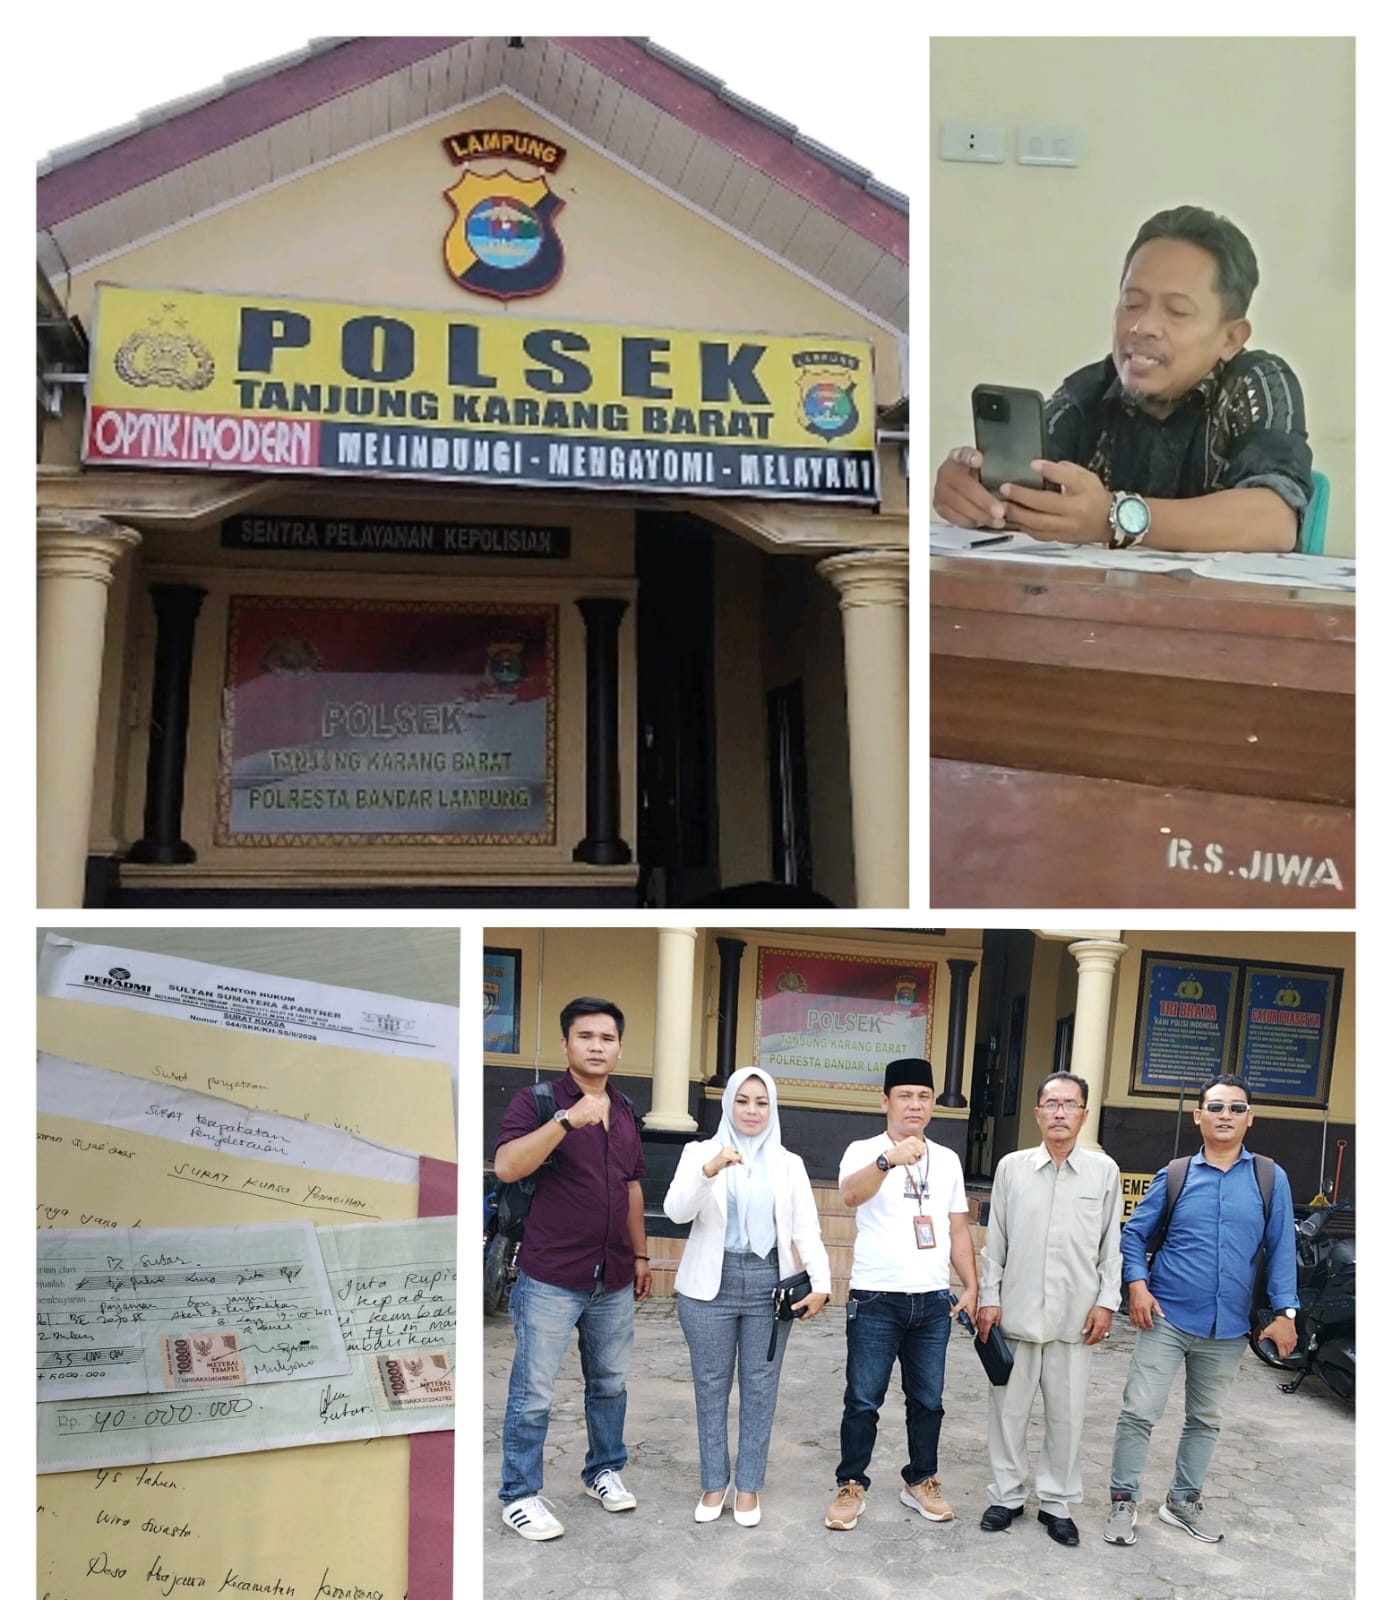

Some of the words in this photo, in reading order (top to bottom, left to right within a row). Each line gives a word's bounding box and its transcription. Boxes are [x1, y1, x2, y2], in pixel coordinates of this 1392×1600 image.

[451, 133, 558, 163] LAMPUNG
[237, 307, 771, 406] POLSEK
[234, 379, 440, 421] TANJUNG
[452, 390, 629, 432] KARANG
[642, 406, 775, 440] BARAT
[338, 431, 522, 474] MELINDUNGI
[549, 443, 715, 483] MENGAYOMI
[741, 452, 872, 490] MELAYANI
[241, 519, 319, 546] SENTRA
[325, 522, 434, 550] PELAYANAN
[444, 527, 551, 552] KEPOLISIAN
[321, 701, 467, 738] POLSEK
[271, 750, 362, 773] TANJUNG
[368, 752, 447, 772] KARANG
[452, 752, 513, 771] BARAT
[249, 787, 348, 810] POLRESTA
[356, 788, 433, 810] BANDAR
[438, 788, 530, 810] LAMPUNG
[84, 974, 152, 993] PERADMI
[217, 984, 257, 996] KANTOR
[259, 991, 296, 1002] HUKUM
[168, 984, 214, 998] SULTAN
[216, 993, 278, 1009] SUMATERA
[190, 1014, 218, 1025] Nomor
[223, 1012, 253, 1024] SURAT
[254, 1017, 286, 1029] KUASA
[807, 1009, 882, 1034] POLSEK
[1160, 1000, 1178, 1018] TRI
[1179, 1002, 1218, 1021] BRATA
[779, 1034, 828, 1048] TANJUNG
[830, 1039, 873, 1052] KARANG
[875, 1042, 908, 1055] BARAT
[769, 1053, 821, 1068] POLRESTA
[824, 1058, 865, 1071] BANDAR
[867, 1061, 887, 1073] LAM
[1121, 1178, 1151, 1196] EME
